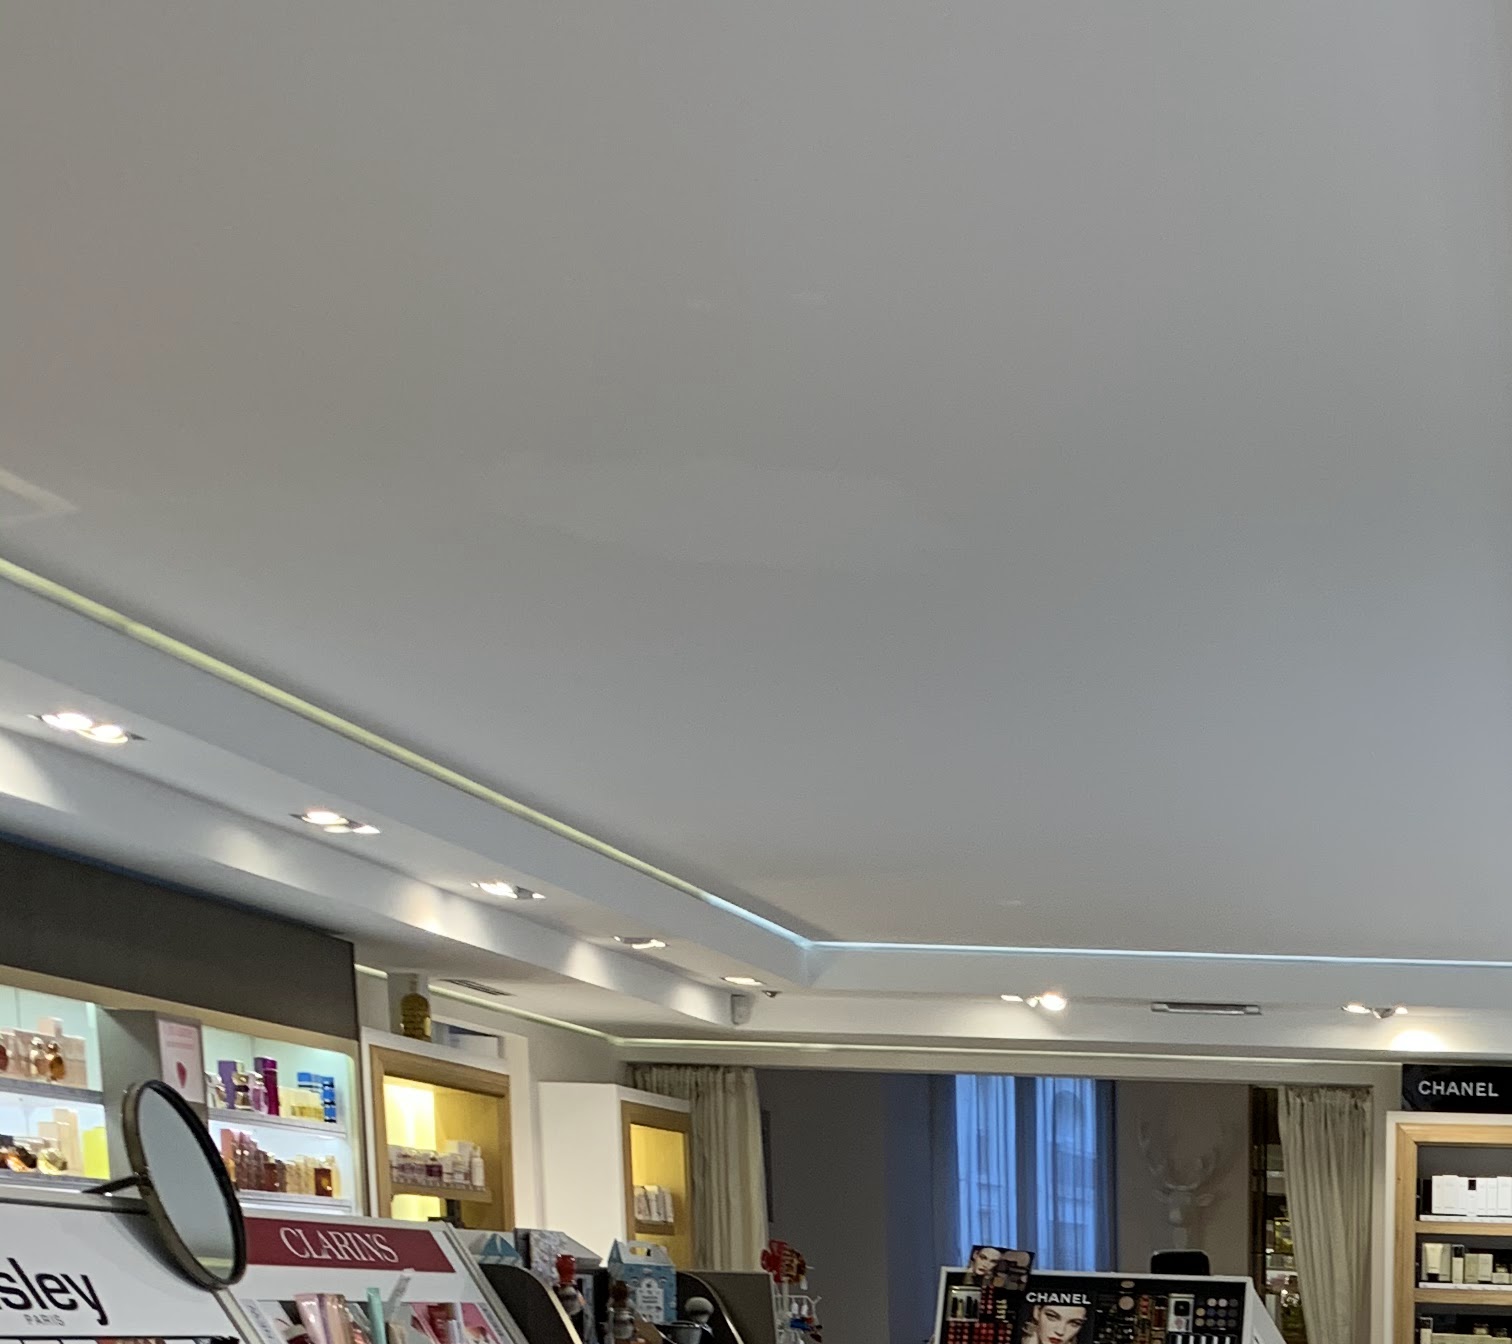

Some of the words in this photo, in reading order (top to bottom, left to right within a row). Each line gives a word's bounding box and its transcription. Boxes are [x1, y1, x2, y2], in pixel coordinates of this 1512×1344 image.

[1418, 1080, 1500, 1098] CHANEL
[279, 1226, 400, 1264] CLARINS
[0, 1257, 109, 1327] sley
[1025, 1291, 1092, 1305] CHANEL
[23, 1313, 66, 1328] PARIS
